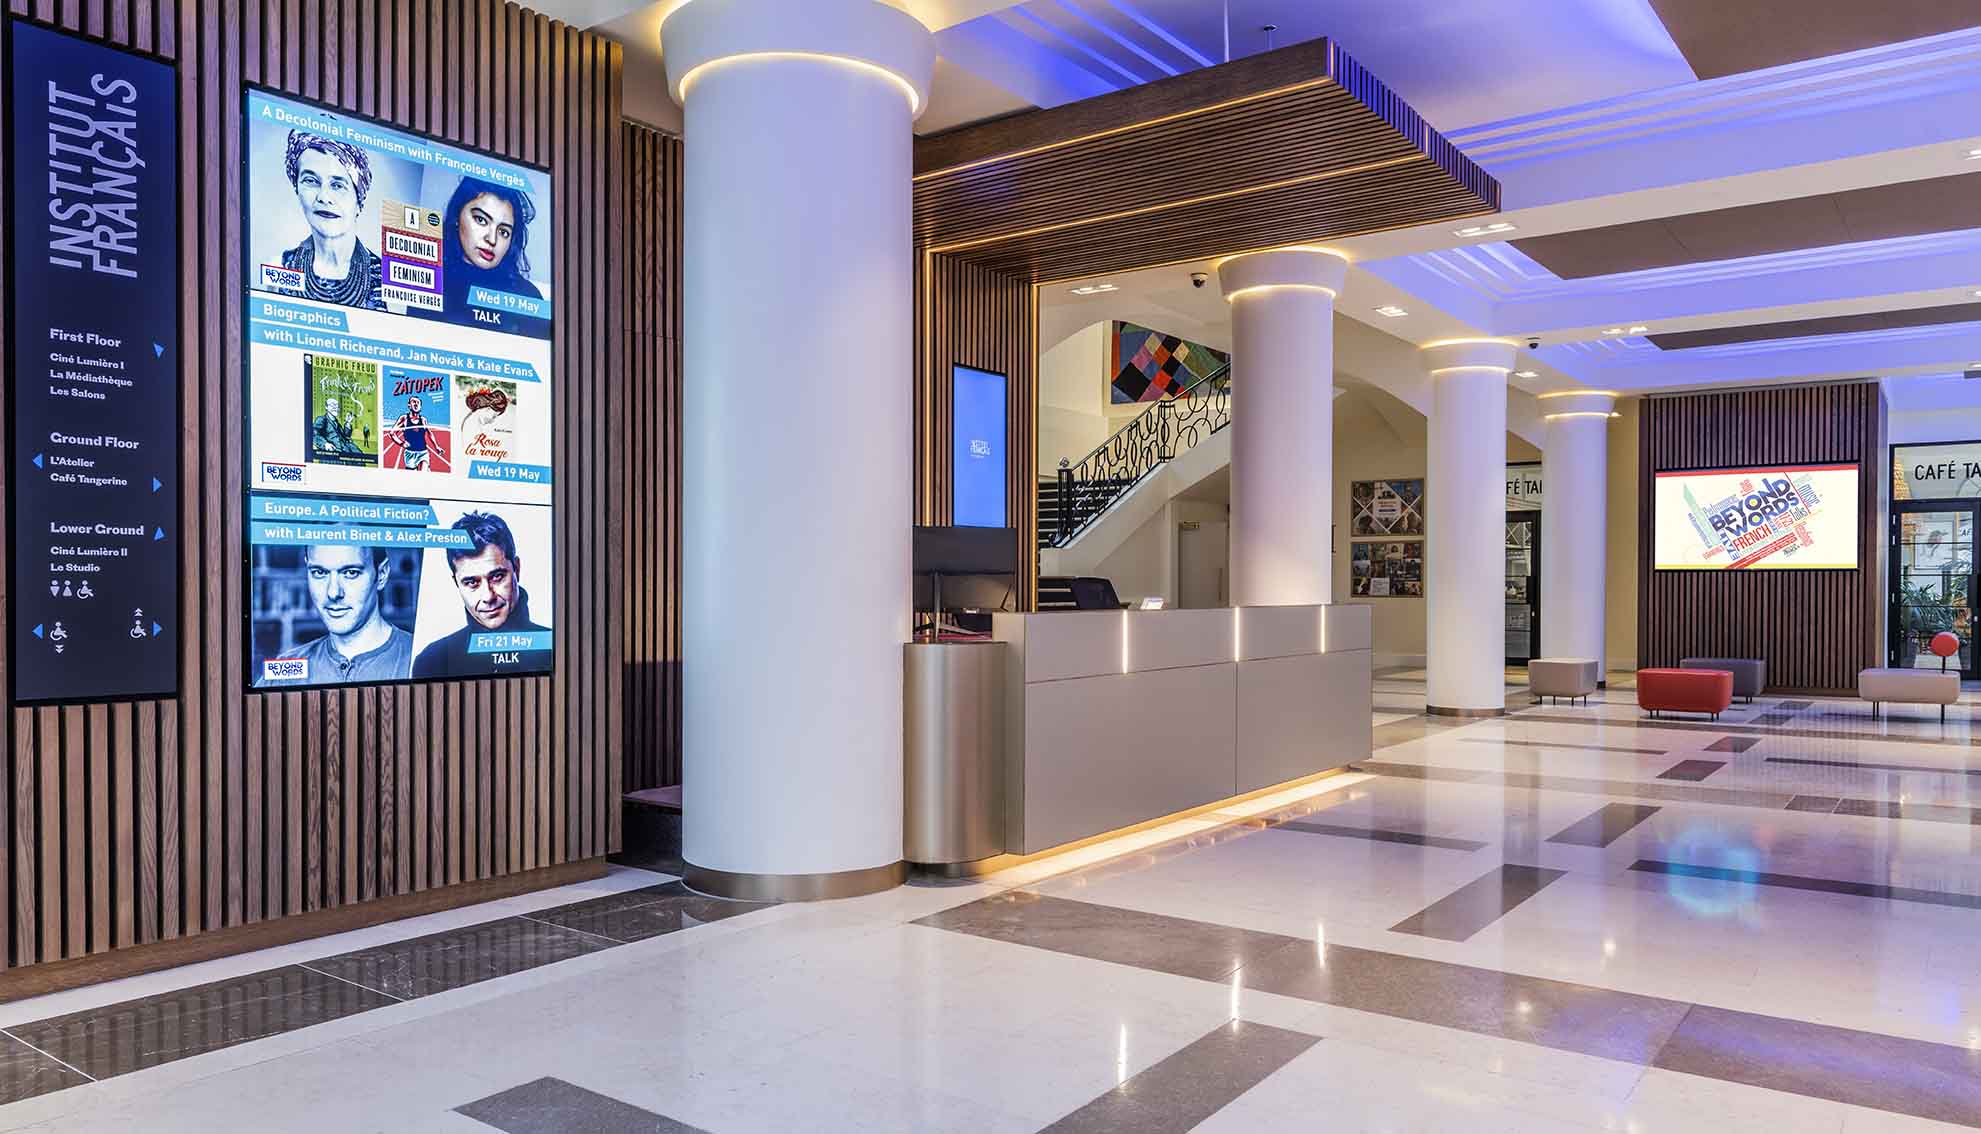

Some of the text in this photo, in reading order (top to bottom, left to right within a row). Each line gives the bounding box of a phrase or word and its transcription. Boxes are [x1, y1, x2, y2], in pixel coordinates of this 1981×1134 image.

[262, 104, 525, 188] A Decolonial Feminism with Françoise Vergès
[48, 80, 96, 268] INSTITUT
[91, 73, 146, 278] FRANÇAIS
[410, 212, 415, 225] A
[390, 236, 435, 258] DECOLONIAL
[266, 268, 300, 280] BEYOND
[270, 276, 300, 287] WORDS
[394, 266, 431, 285] FEMINISM
[476, 290, 540, 313] Wed 19 May
[264, 304, 341, 328] Biographics
[473, 309, 501, 324] TALK
[50, 328, 121, 348] First Floor
[50, 353, 74, 364] Ciné
[77, 356, 119, 369] Lumière
[264, 328, 534, 378] with Lionel Richerand, Jan Novák & Kate Evans
[315, 357, 375, 373] GRAPHIC FREUD
[50, 370, 133, 387] La Médiathèque
[393, 377, 444, 396] ZÁTOPEK
[50, 386, 106, 400] Les Salons
[50, 432, 140, 449] Ground Floor
[474, 433, 500, 448] Rosa
[480, 449, 508, 463] rouge
[267, 466, 302, 475] BEYOND
[271, 473, 302, 482] WORDS
[477, 464, 540, 482] Wed 19 May
[1914, 460, 1956, 480] CAFÉ
[50, 473, 128, 486] Café Tangerine
[265, 502, 429, 521] Europe. A Political Fiction?
[1708, 478, 1790, 532] BEYOND
[1725, 492, 1799, 536] WORDS
[50, 522, 144, 535] Lower Ground
[264, 527, 467, 544] with Laurent Binet & Alex Preston
[1733, 524, 1772, 552] FRENCH
[50, 546, 75, 556] Ciné
[77, 547, 119, 556] Lumière
[50, 563, 100, 572] Le Studio
[477, 636, 532, 648] Fri 21 May
[268, 661, 303, 670] BEYOND
[492, 653, 519, 665] TALK
[273, 669, 303, 677] WORDS
